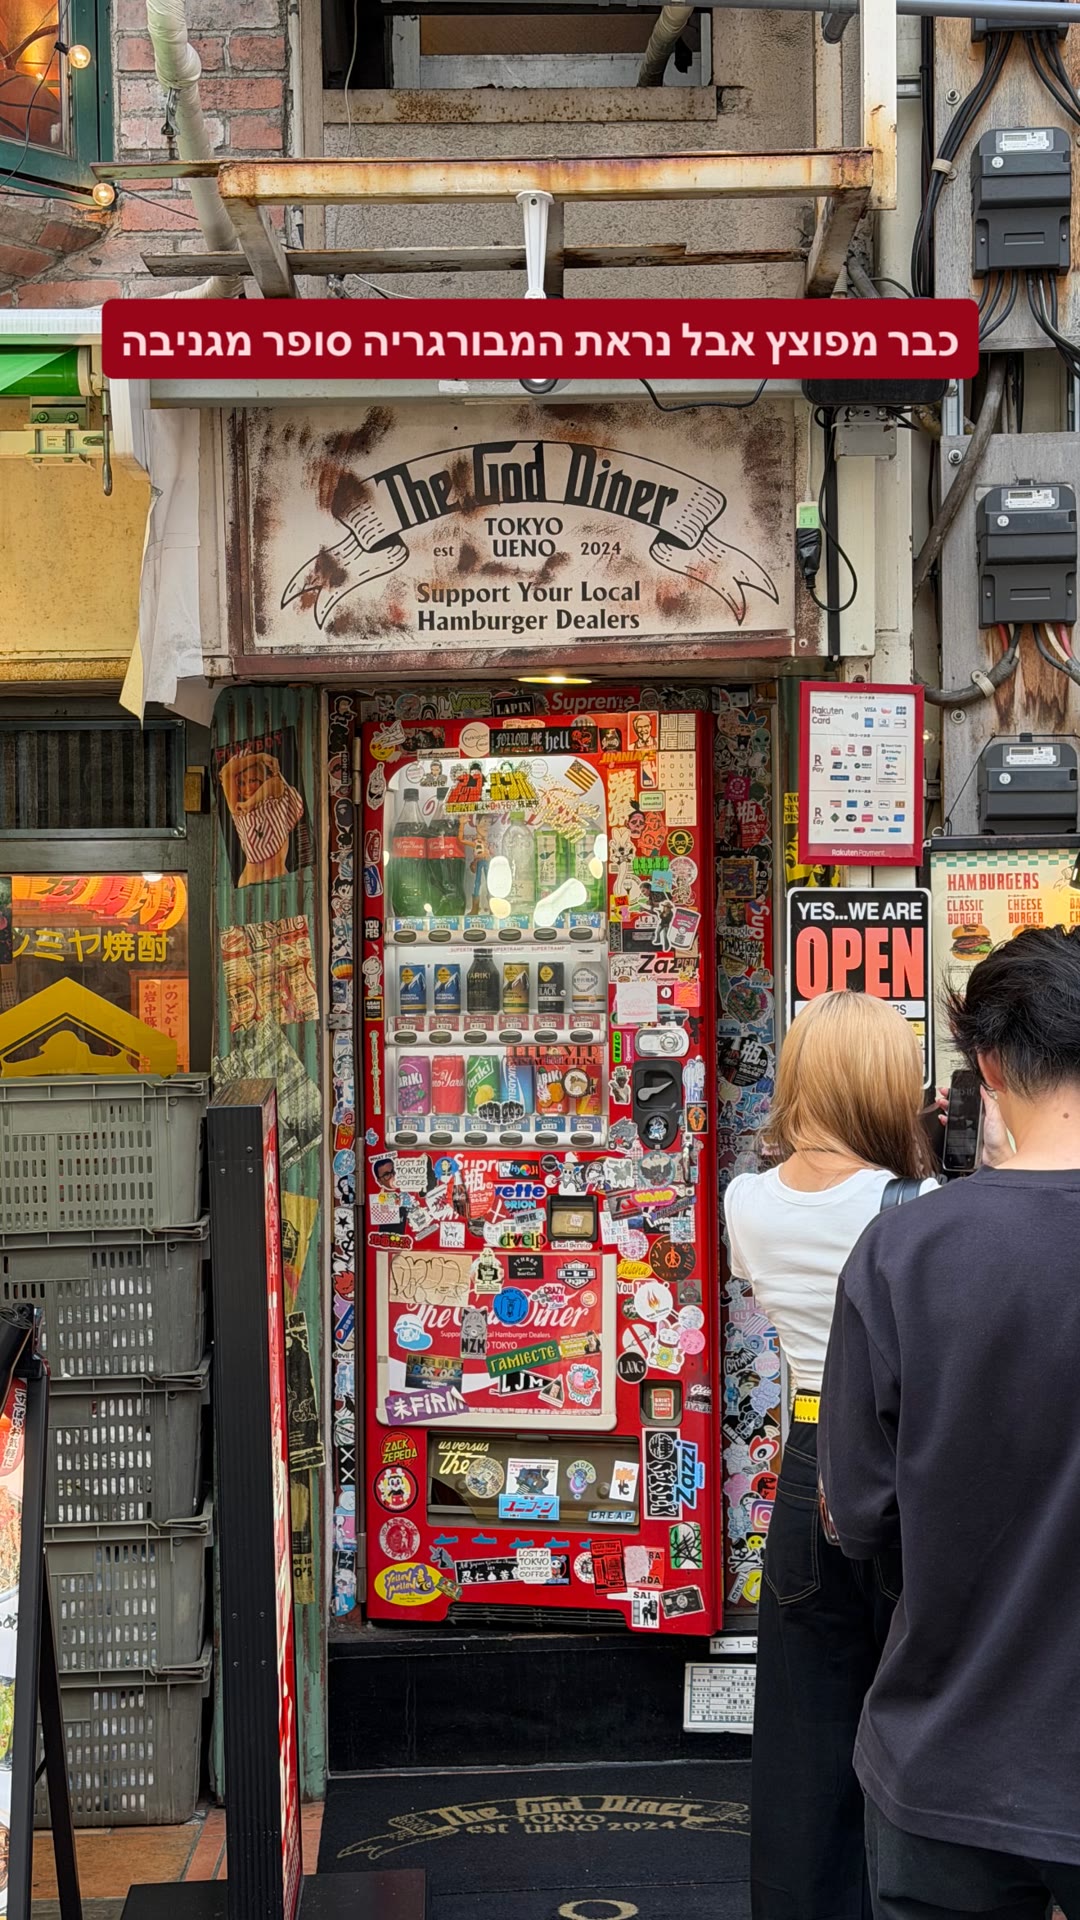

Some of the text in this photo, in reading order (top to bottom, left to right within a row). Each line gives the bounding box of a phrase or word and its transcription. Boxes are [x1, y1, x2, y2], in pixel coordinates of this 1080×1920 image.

[374, 440, 679, 529] The God Diner
[484, 517, 563, 536] TOKYO
[433, 539, 622, 557] est UENO 2024
[417, 581, 640, 607] Support Your Local
[418, 608, 640, 633] Hamburger Dealers
[496, 701, 530, 715] LAPIN
[812, 706, 844, 715] Rakuten
[545, 730, 570, 752] hell
[947, 873, 1039, 891] HAMBURGERS
[882, 902, 922, 920] ARE
[947, 900, 984, 911] CLASSIC
[1008, 898, 1042, 910] CHEESE
[365, 920, 379, 929] YOU
[948, 913, 983, 925] BURGER
[1008, 912, 1044, 924] BURGER
[365, 930, 379, 938] FES
[717, 925, 753, 939] Google
[796, 926, 924, 999] OPEN
[386, 1439, 408, 1453] ZACK
[452, 1441, 489, 1452] versus
[382, 1448, 418, 1464] ZEPEDA
[675, 1443, 697, 1507] Zazzi
[432, 1797, 704, 1826] The God Diner
[466, 1819, 677, 1834] est UENO 2024
[519, 1814, 606, 1825] TOKYO
